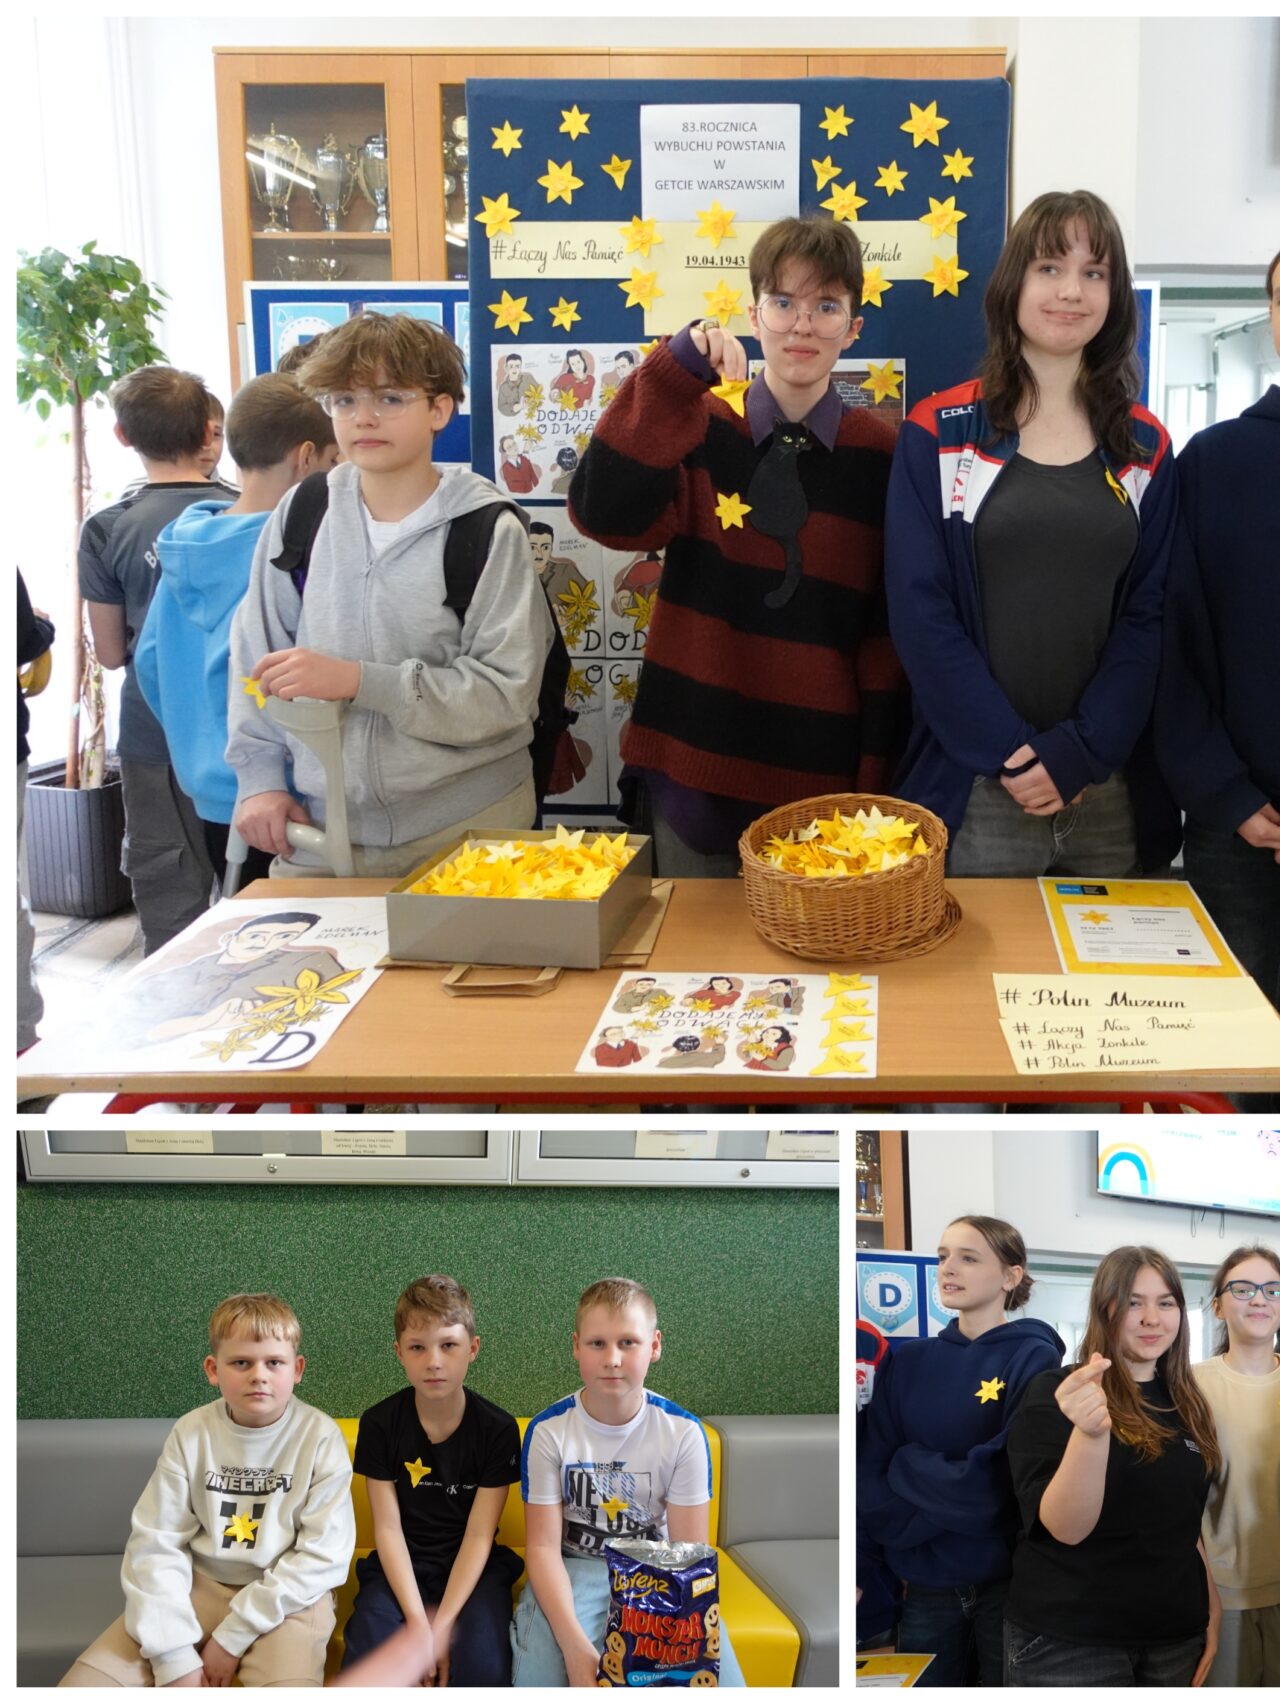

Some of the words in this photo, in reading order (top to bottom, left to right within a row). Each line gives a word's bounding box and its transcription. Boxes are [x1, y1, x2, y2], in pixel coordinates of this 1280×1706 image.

[654, 140, 713, 152] WYBUCHU
[716, 140, 786, 152] POWSTANIA
[713, 159, 726, 170] W
[655, 180, 693, 191] GETCIE
[697, 179, 785, 191] WARSZAWSKIM
[552, 240, 578, 261] Nas
[685, 255, 746, 267] 19.04.1943
[537, 409, 597, 422] DODAJE
[537, 423, 594, 435] ODWA
[1028, 988, 1093, 1008] Polin
[1105, 991, 1187, 1009] Muzeum
[1097, 1018, 1131, 1032] Nas
[879, 1283, 902, 1308] D
[614, 1568, 671, 1594] Lorenz
[632, 1636, 701, 1665] MUNCH
